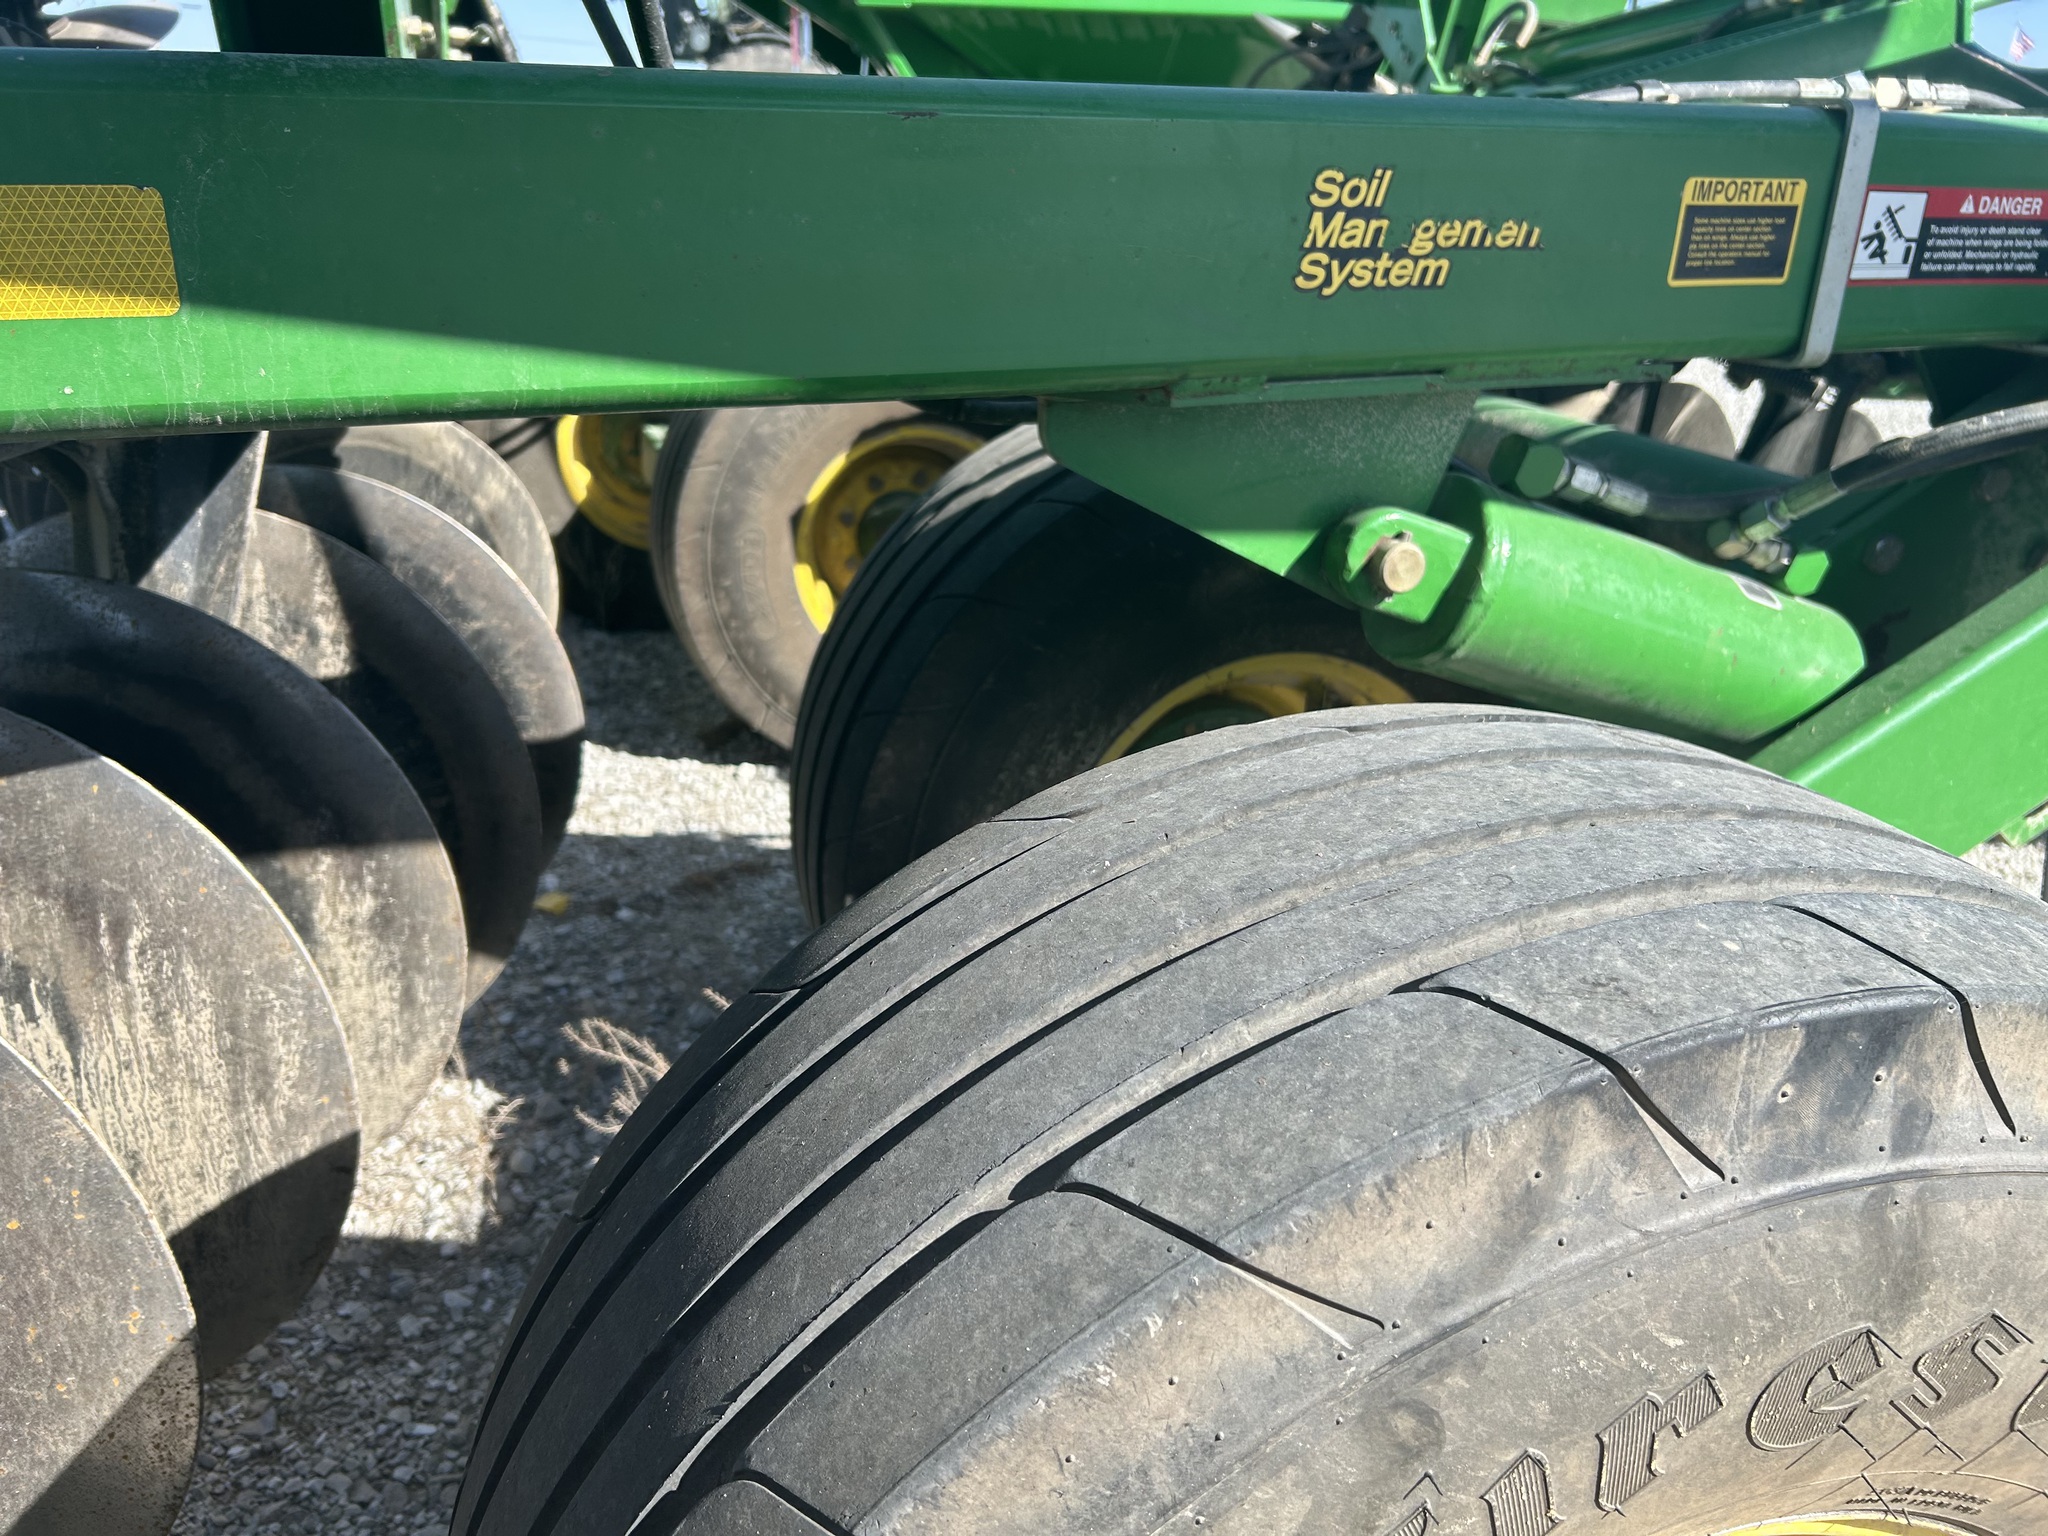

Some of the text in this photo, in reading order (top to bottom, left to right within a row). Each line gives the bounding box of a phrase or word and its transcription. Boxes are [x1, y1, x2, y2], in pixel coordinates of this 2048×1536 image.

[1309, 168, 1394, 208] Soil
[1691, 180, 1799, 202] IMPORTANT
[1978, 196, 2043, 215] DANGER
[1960, 225, 1979, 235] injury
[1935, 238, 1964, 248] machine
[1295, 252, 1450, 296] System
